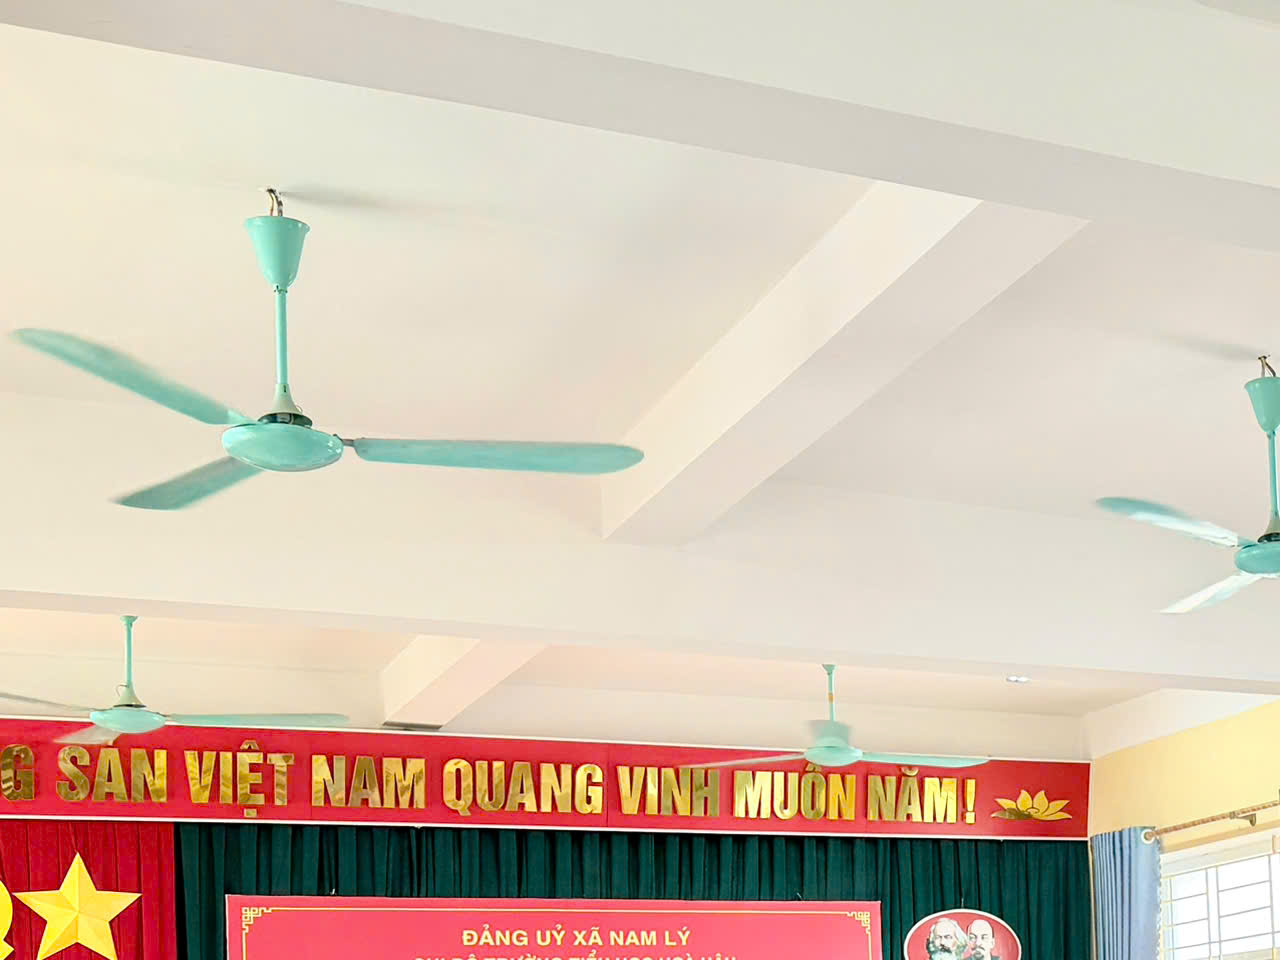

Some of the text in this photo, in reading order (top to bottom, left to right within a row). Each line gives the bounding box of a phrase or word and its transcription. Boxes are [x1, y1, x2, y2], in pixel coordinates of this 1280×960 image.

[184, 740, 295, 818] VIỆT
[311, 755, 426, 809] NAM
[442, 758, 603, 816] QUANG
[617, 766, 720, 817] VINH
[462, 924, 690, 946] ĐẢNG UỶ XÃ NAM LÝ
